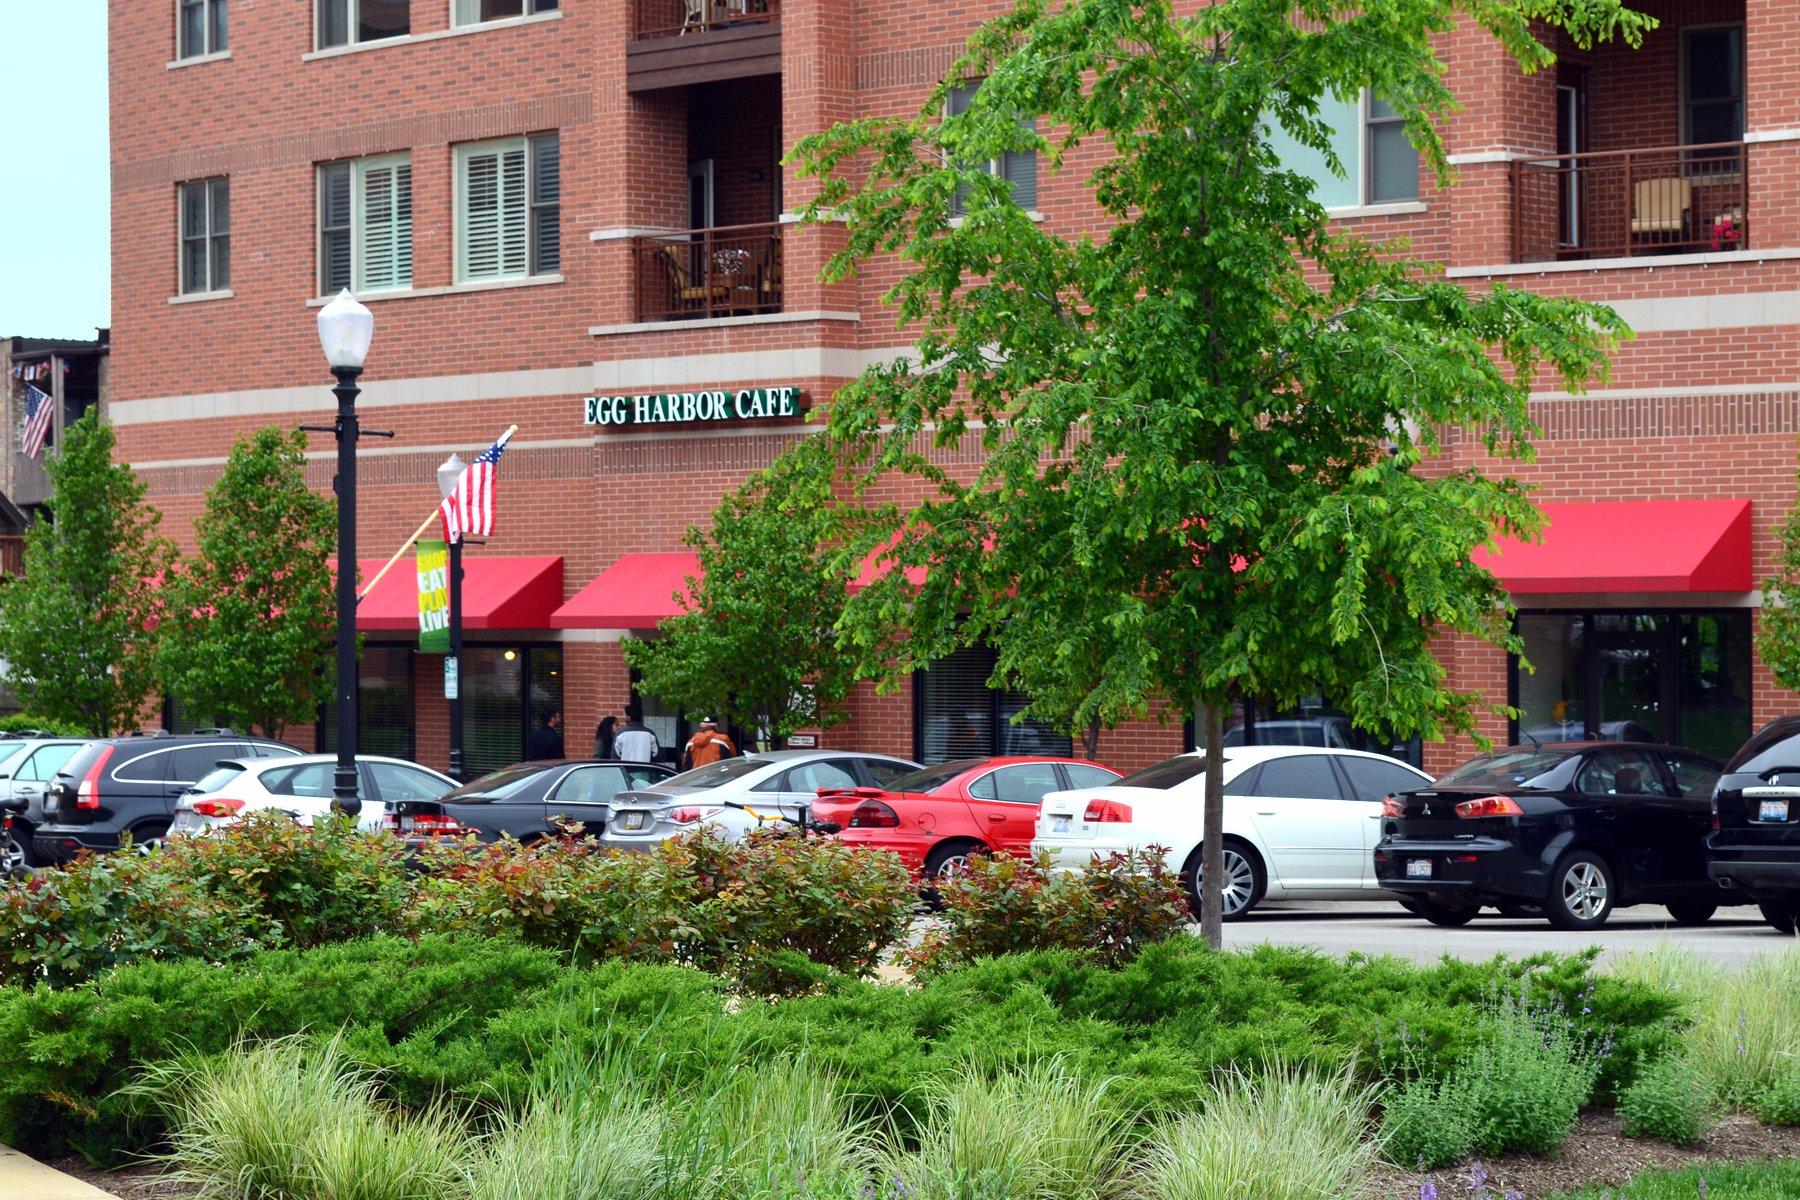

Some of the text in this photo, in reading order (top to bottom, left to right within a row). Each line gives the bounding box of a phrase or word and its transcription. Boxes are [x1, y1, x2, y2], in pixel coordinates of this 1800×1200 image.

[583, 387, 793, 425] EGG HARBOR CAFE
[417, 550, 447, 573] SHOP
[417, 567, 447, 592] EAT
[419, 606, 449, 633] LIVE
